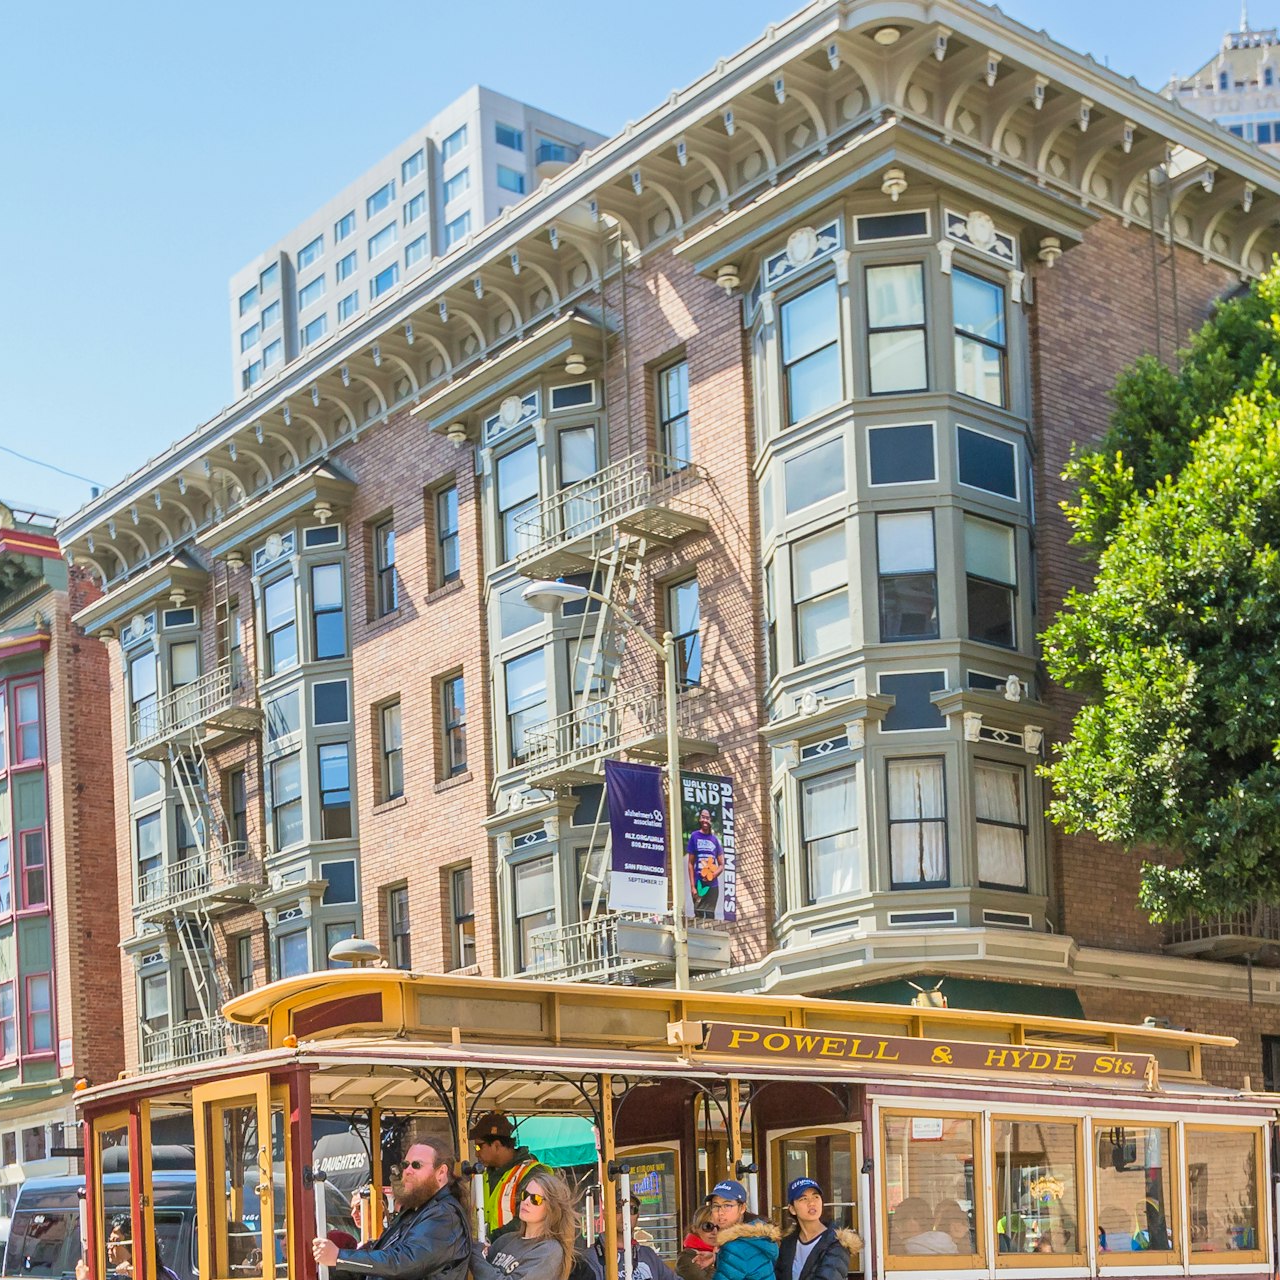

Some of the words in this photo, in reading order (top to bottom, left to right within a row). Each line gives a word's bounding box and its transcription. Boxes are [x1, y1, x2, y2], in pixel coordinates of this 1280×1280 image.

[682, 779, 707, 789] WALK
[707, 780, 719, 791] TO
[684, 787, 720, 805] END
[625, 809, 653, 819] alzheimer's
[634, 818, 662, 828] association
[720, 782, 736, 913] ALZHEIMER'S
[636, 864, 664, 874] FRANCISCO
[628, 877, 657, 885] SEPTEMBER
[728, 1029, 900, 1061] POWELL
[930, 1046, 954, 1065] &
[985, 1049, 1076, 1072] HYDE
[320, 1153, 367, 1172] DAUGHTERS
